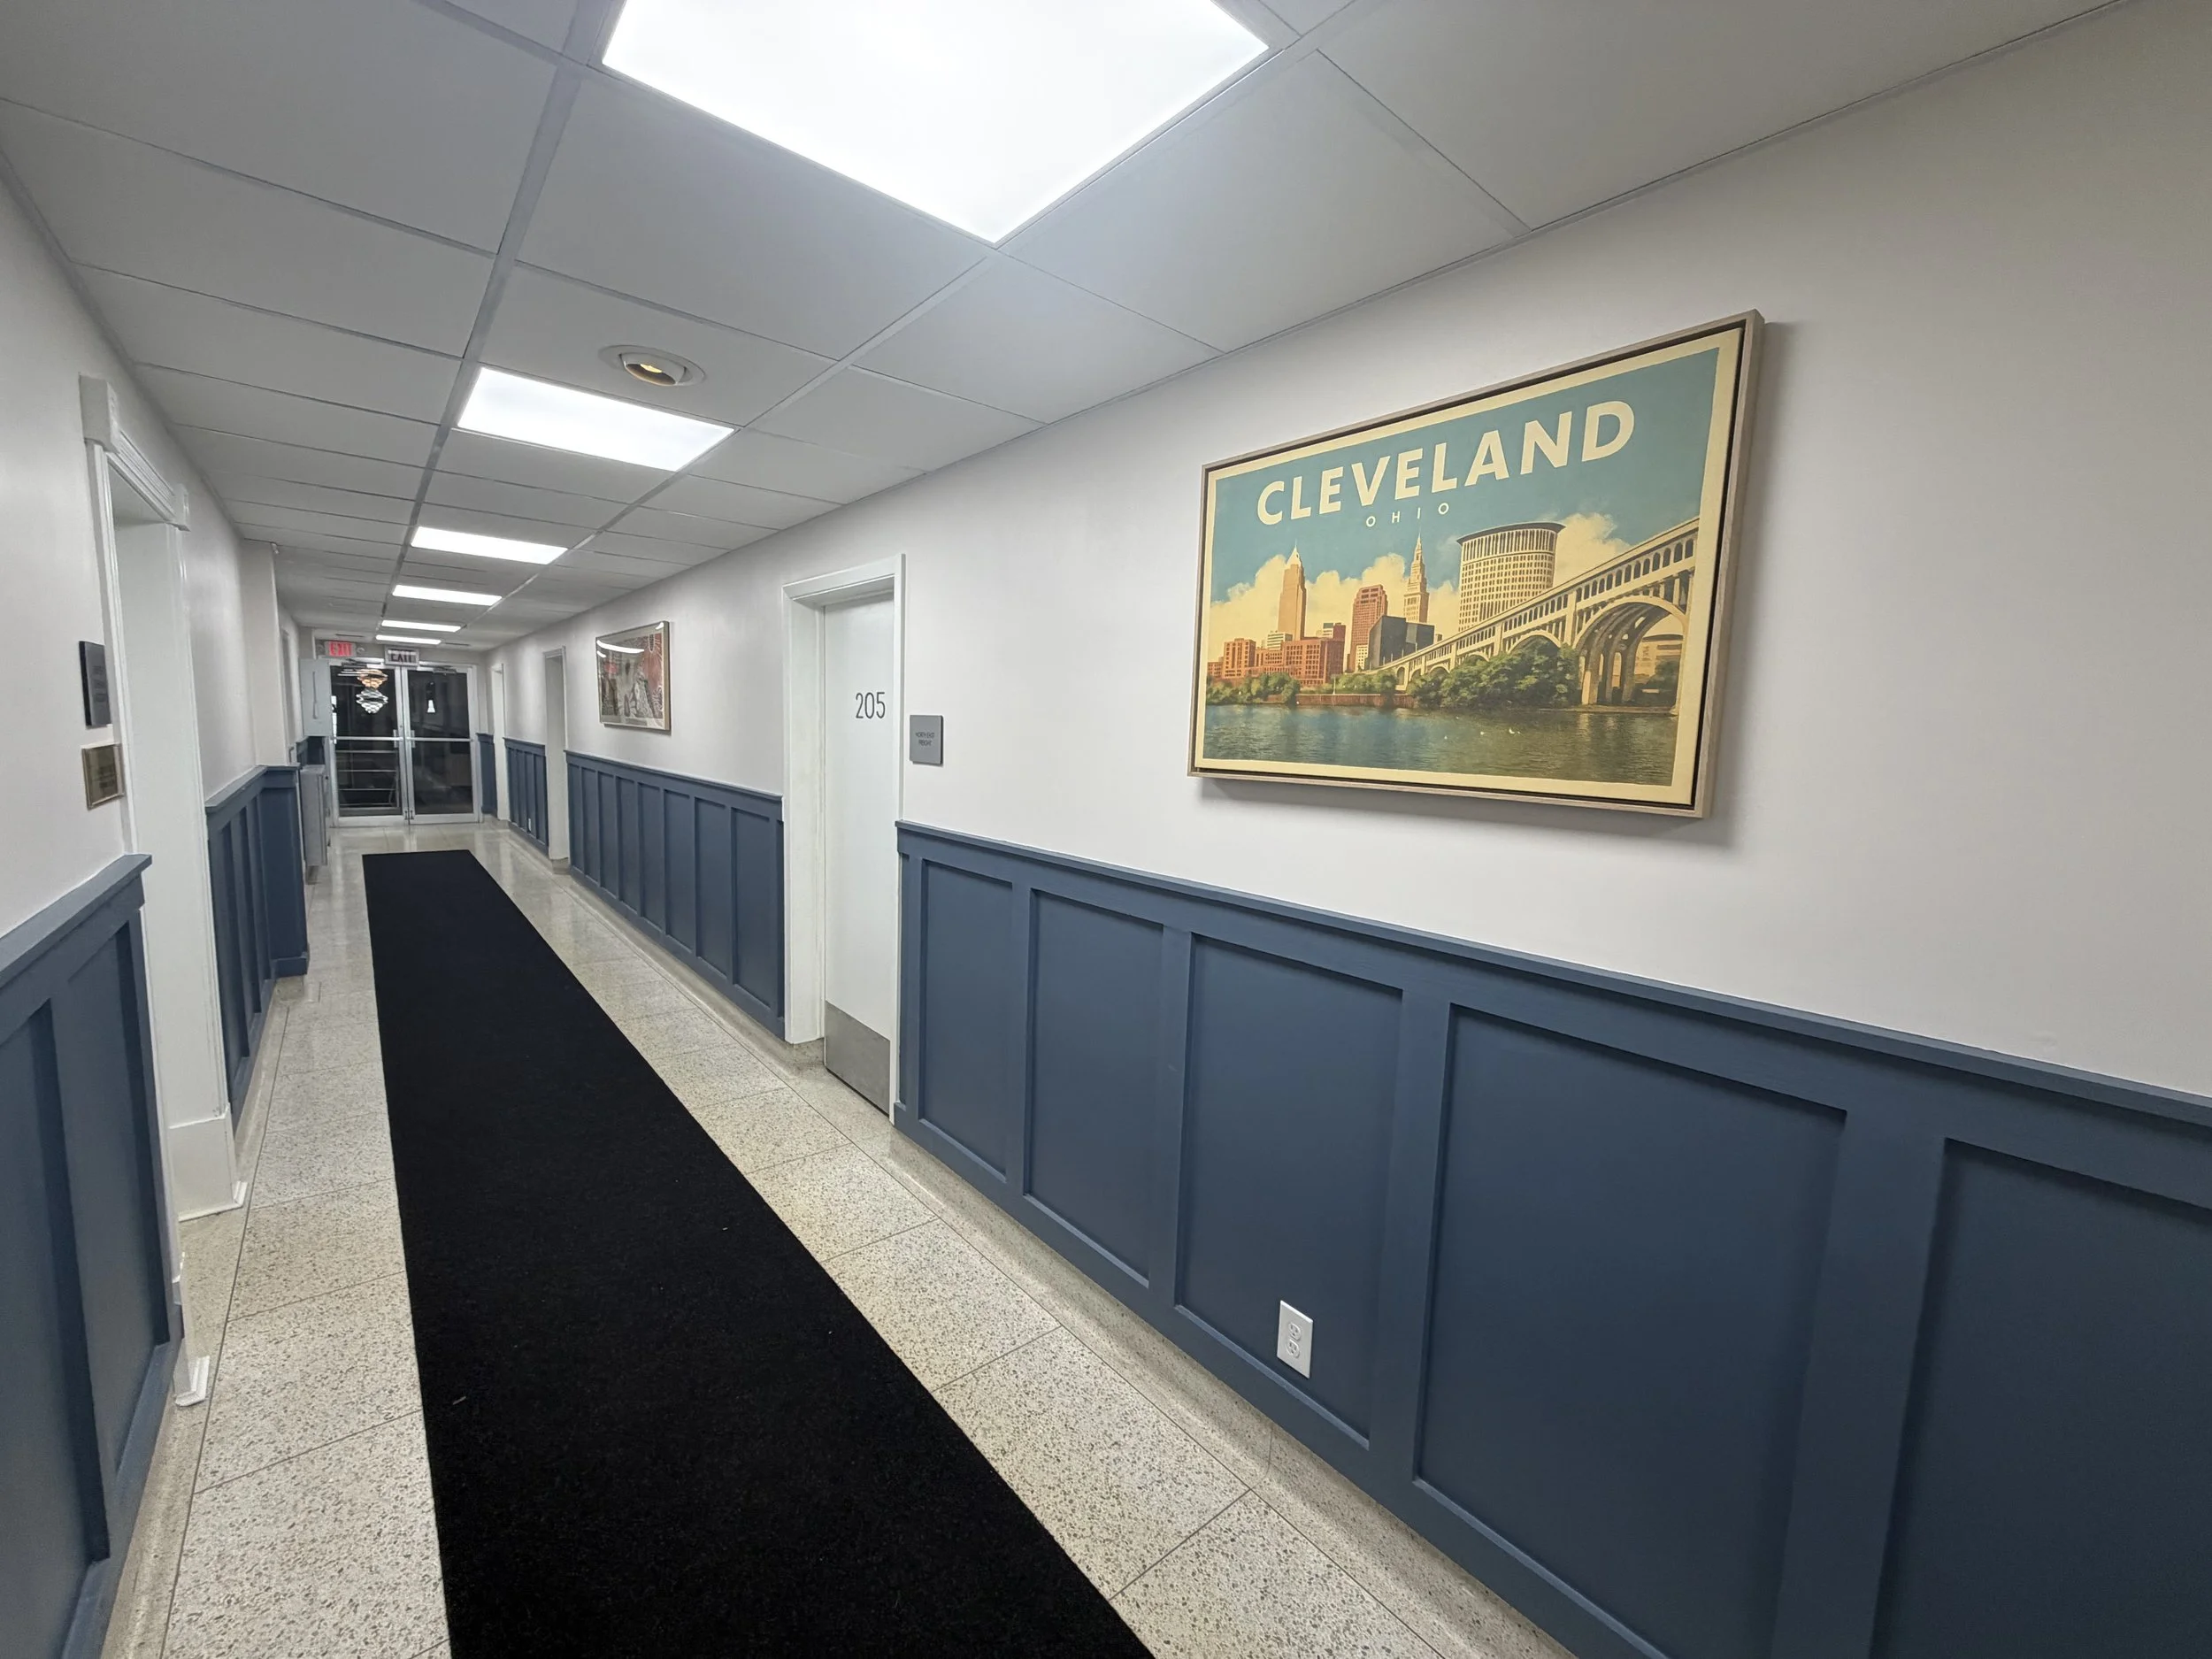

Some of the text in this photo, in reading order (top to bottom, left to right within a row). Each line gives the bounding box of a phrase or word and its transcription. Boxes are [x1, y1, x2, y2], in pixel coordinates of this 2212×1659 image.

[1256, 400, 1635, 526] CLEVELAND
[1365, 502, 1450, 528] OHIO
[329, 642, 352, 657] EXIT
[855, 691, 886, 719] 205
